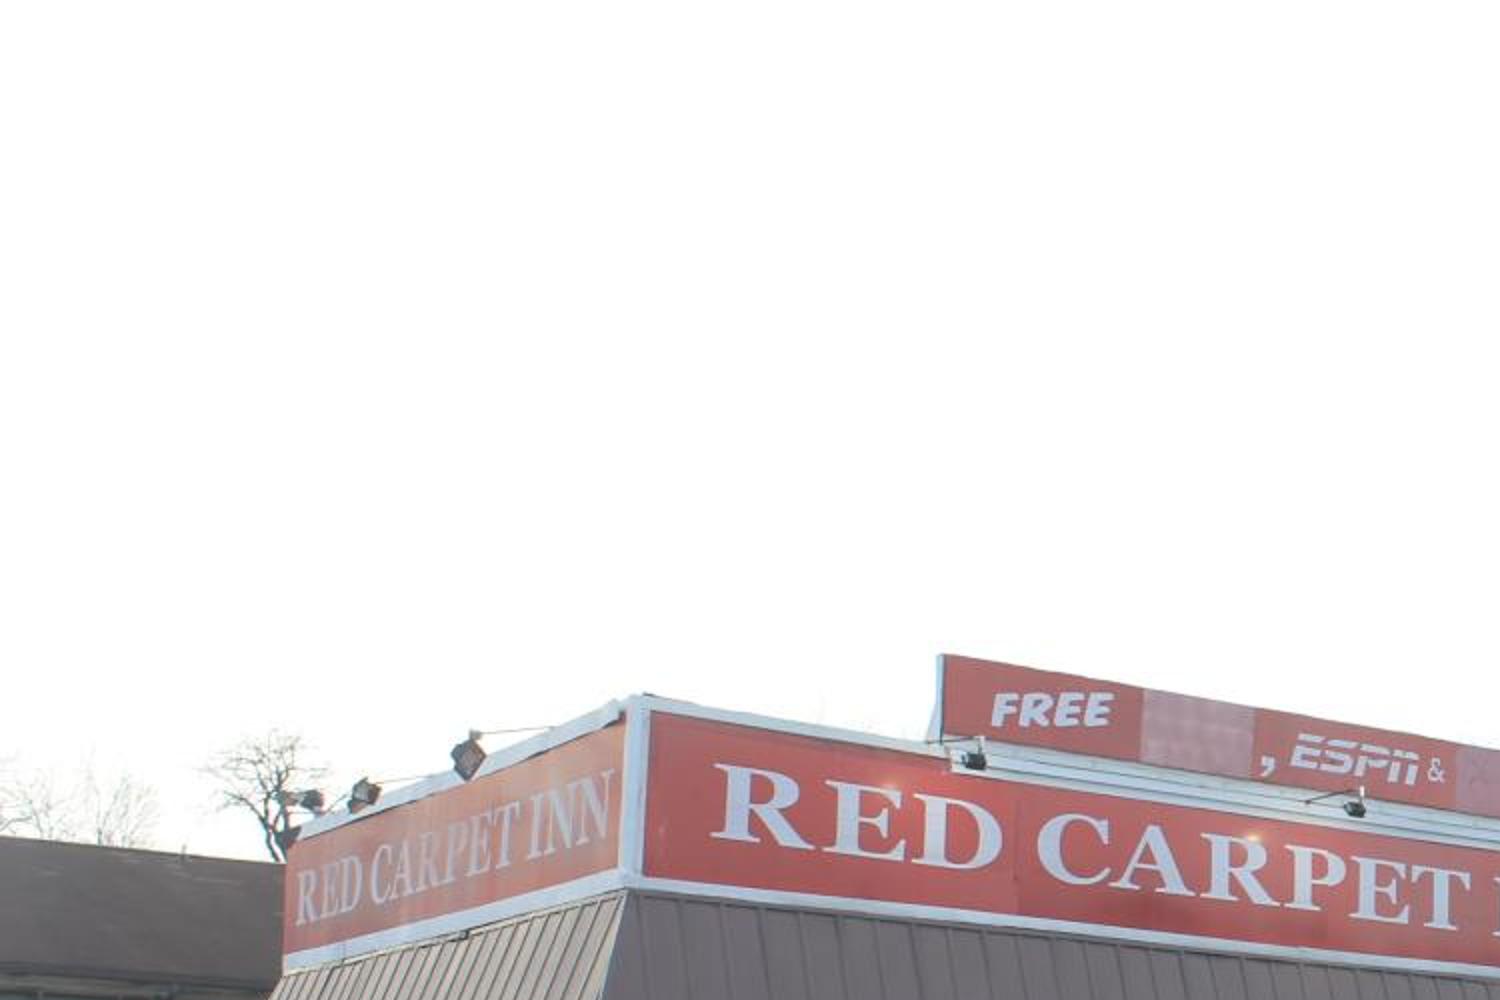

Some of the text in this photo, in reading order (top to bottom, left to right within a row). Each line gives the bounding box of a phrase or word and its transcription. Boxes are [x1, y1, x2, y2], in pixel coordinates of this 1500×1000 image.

[992, 692, 1115, 728] FREE
[1290, 733, 1420, 785] ESPN
[1427, 757, 1446, 783] &
[295, 769, 615, 926] RED CARPET INN
[709, 763, 1003, 870] RED
[1037, 813, 1471, 931] CARPET
